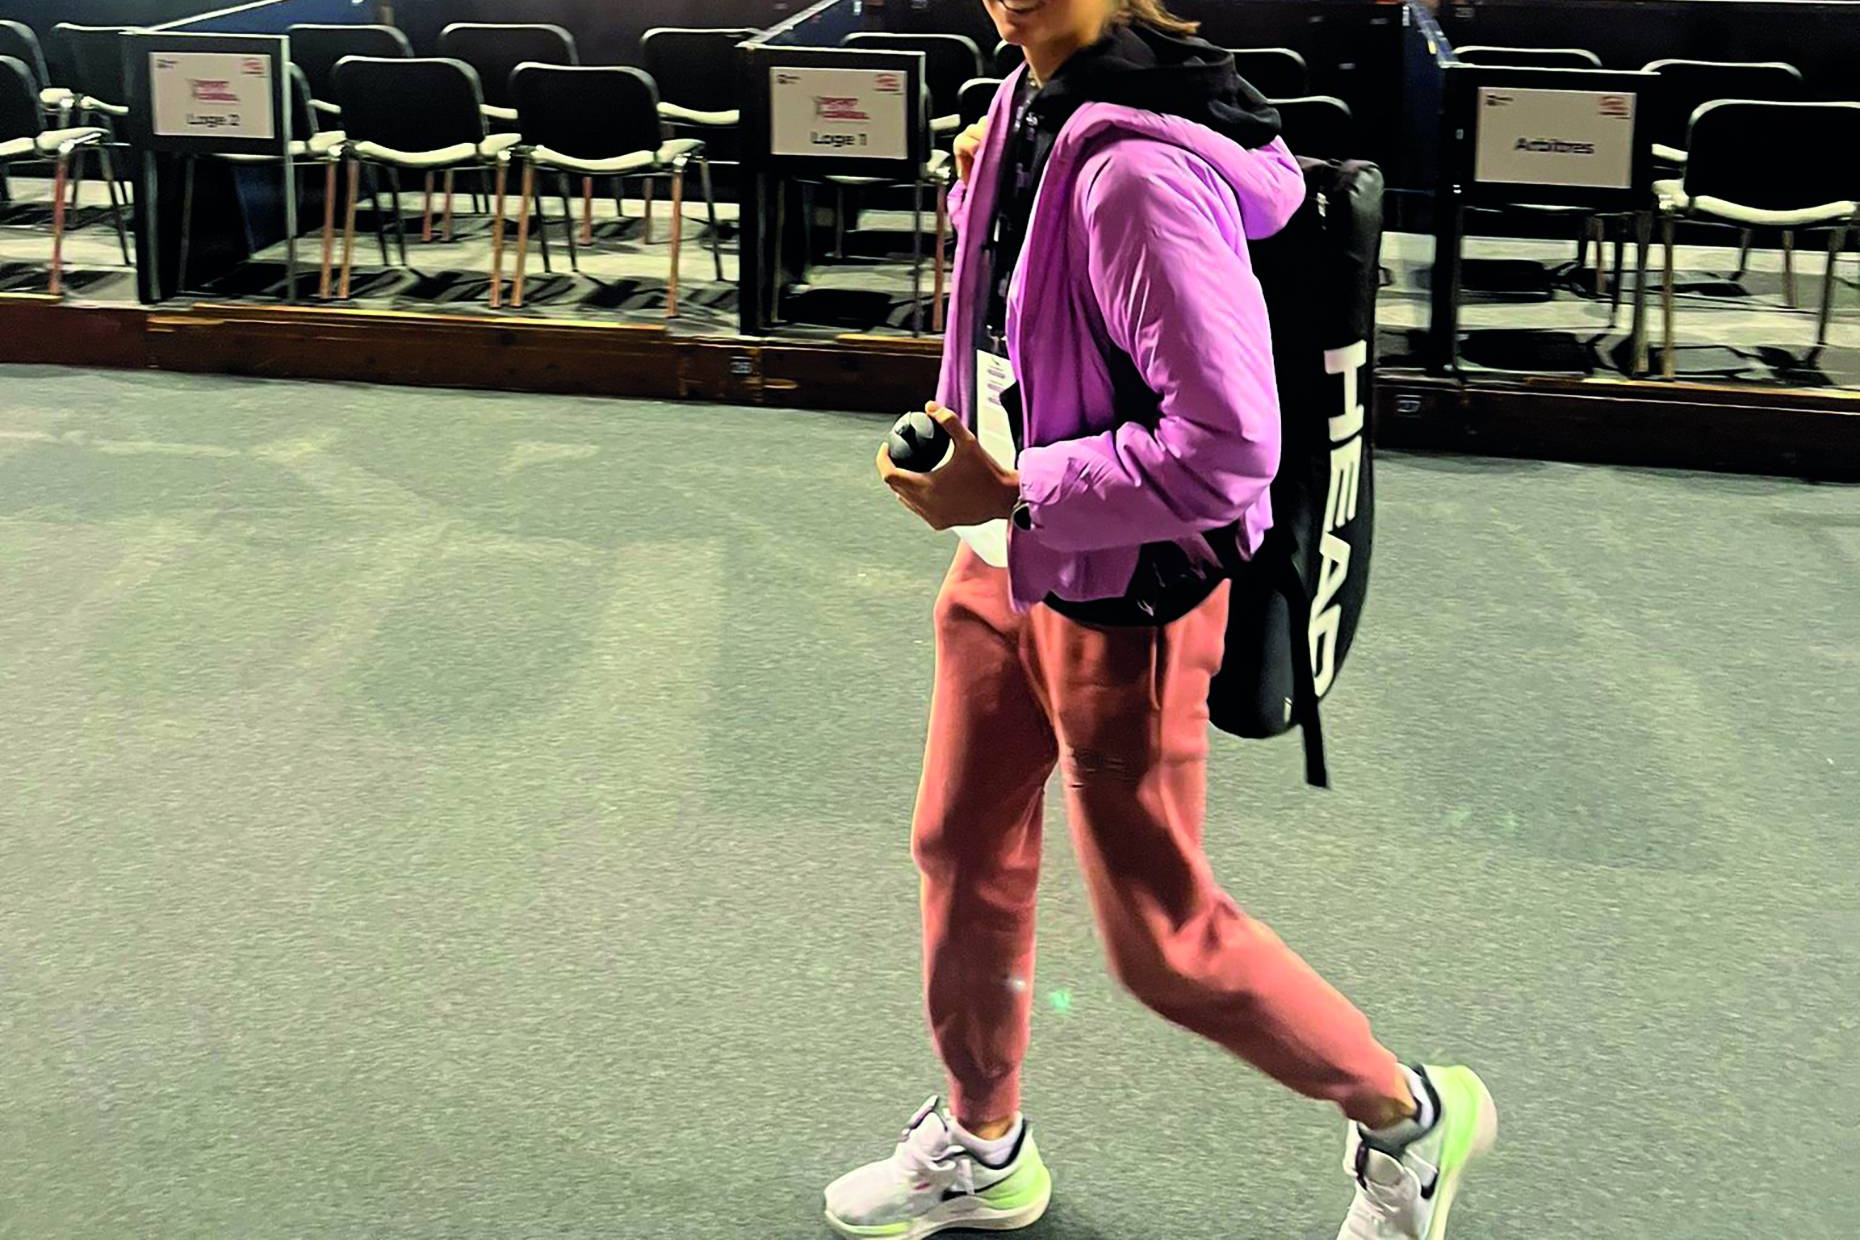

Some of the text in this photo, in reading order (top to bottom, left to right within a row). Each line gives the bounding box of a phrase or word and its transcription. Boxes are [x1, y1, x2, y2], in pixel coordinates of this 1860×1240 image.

[186, 113, 240, 128] Loge 2
[810, 131, 868, 148] Loge 1
[1309, 339, 1368, 698] HEAD
